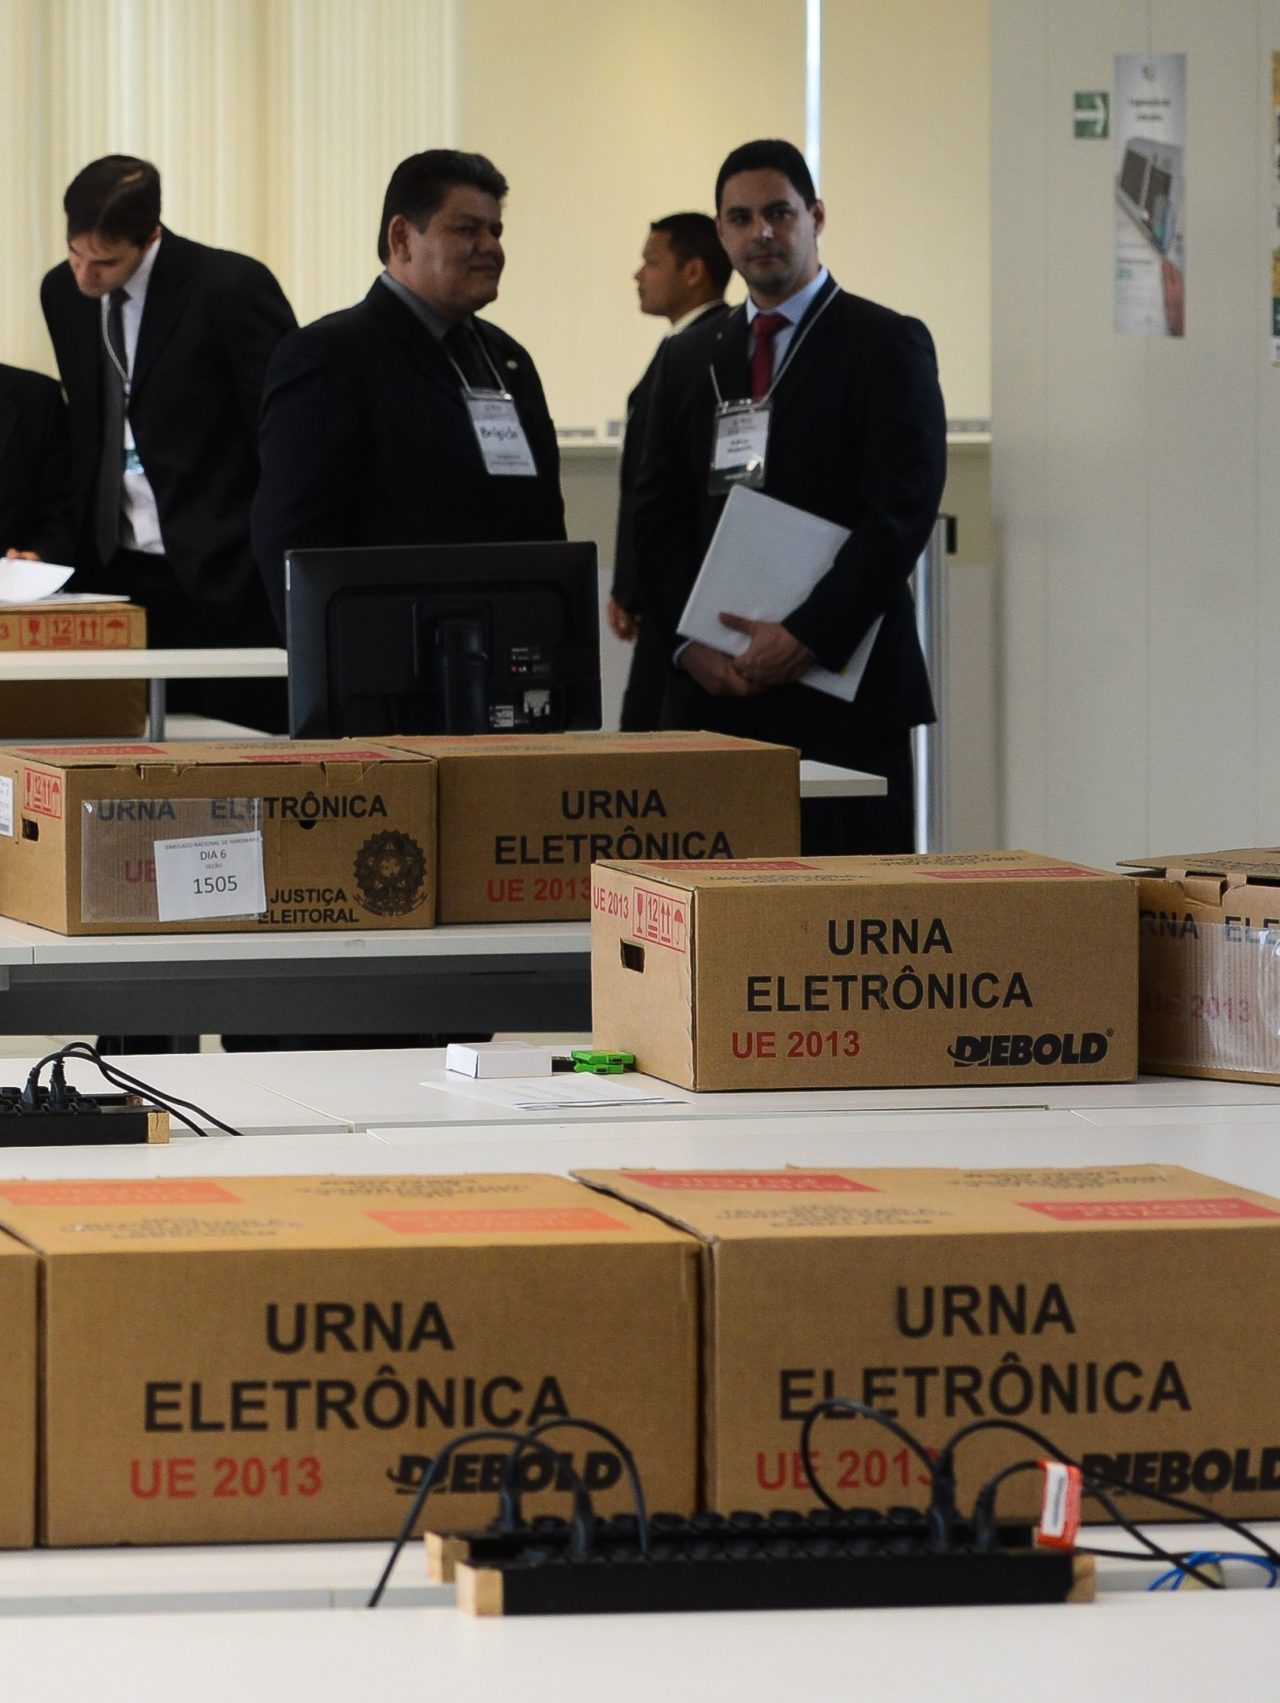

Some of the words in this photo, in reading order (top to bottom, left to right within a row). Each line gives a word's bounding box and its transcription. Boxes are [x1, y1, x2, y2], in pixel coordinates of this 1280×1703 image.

[53, 619, 71, 635] 12
[96, 798, 177, 822] URNA
[210, 790, 388, 820] ELETRÔNICA
[562, 789, 668, 820] URNA
[200, 850, 218, 861] DIA
[220, 849, 227, 859] 6
[495, 825, 735, 865] ELETRÔNICA
[125, 860, 156, 884] UE
[193, 875, 238, 895] 1505
[270, 887, 348, 908] JUSTIÇA
[487, 878, 525, 903] UE
[593, 886, 606, 912] UE
[608, 891, 629, 919] 2013
[258, 907, 360, 924] ELEITORAL
[648, 896, 658, 923] 12
[828, 918, 953, 956] URNA
[1139, 908, 1199, 940] RNA
[1225, 914, 1280, 946] ELE
[747, 965, 1033, 1012] ELETRÔNICA
[1190, 995, 1249, 1022] 2013
[732, 1031, 777, 1059] UE
[787, 1030, 862, 1059] 2013
[947, 1031, 1110, 1069] DIEBOLD
[897, 1283, 1077, 1339] URNA
[266, 1301, 455, 1355] URNA
[144, 1365, 572, 1433] ELETRÔNICA
[779, 1351, 1192, 1421] ELETRÔNICA
[129, 1458, 197, 1499] UE
[213, 1456, 324, 1498] 2013
[756, 1451, 821, 1491] UE
